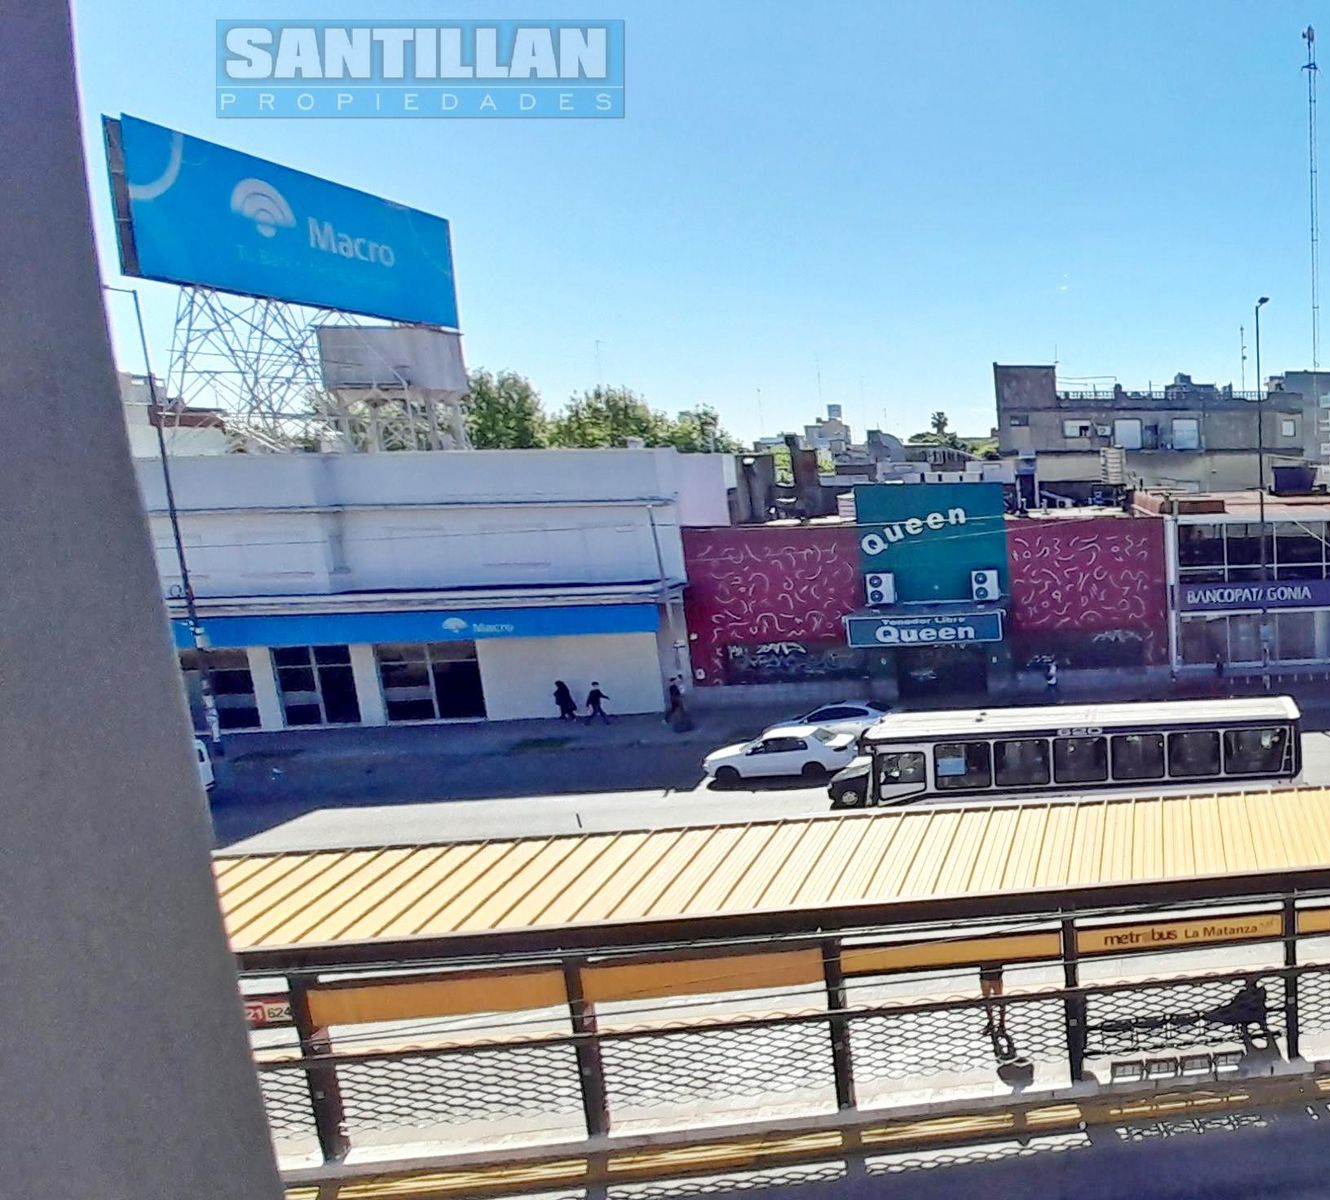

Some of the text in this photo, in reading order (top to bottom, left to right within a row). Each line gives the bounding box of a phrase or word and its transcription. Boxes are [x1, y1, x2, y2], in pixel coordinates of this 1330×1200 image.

[307, 216, 395, 268] Macro
[861, 507, 966, 555] Queen
[472, 623, 515, 633] Macro
[875, 625, 975, 643] Queen
[1184, 928, 1200, 940] La
[1203, 923, 1259, 938] Matanza
